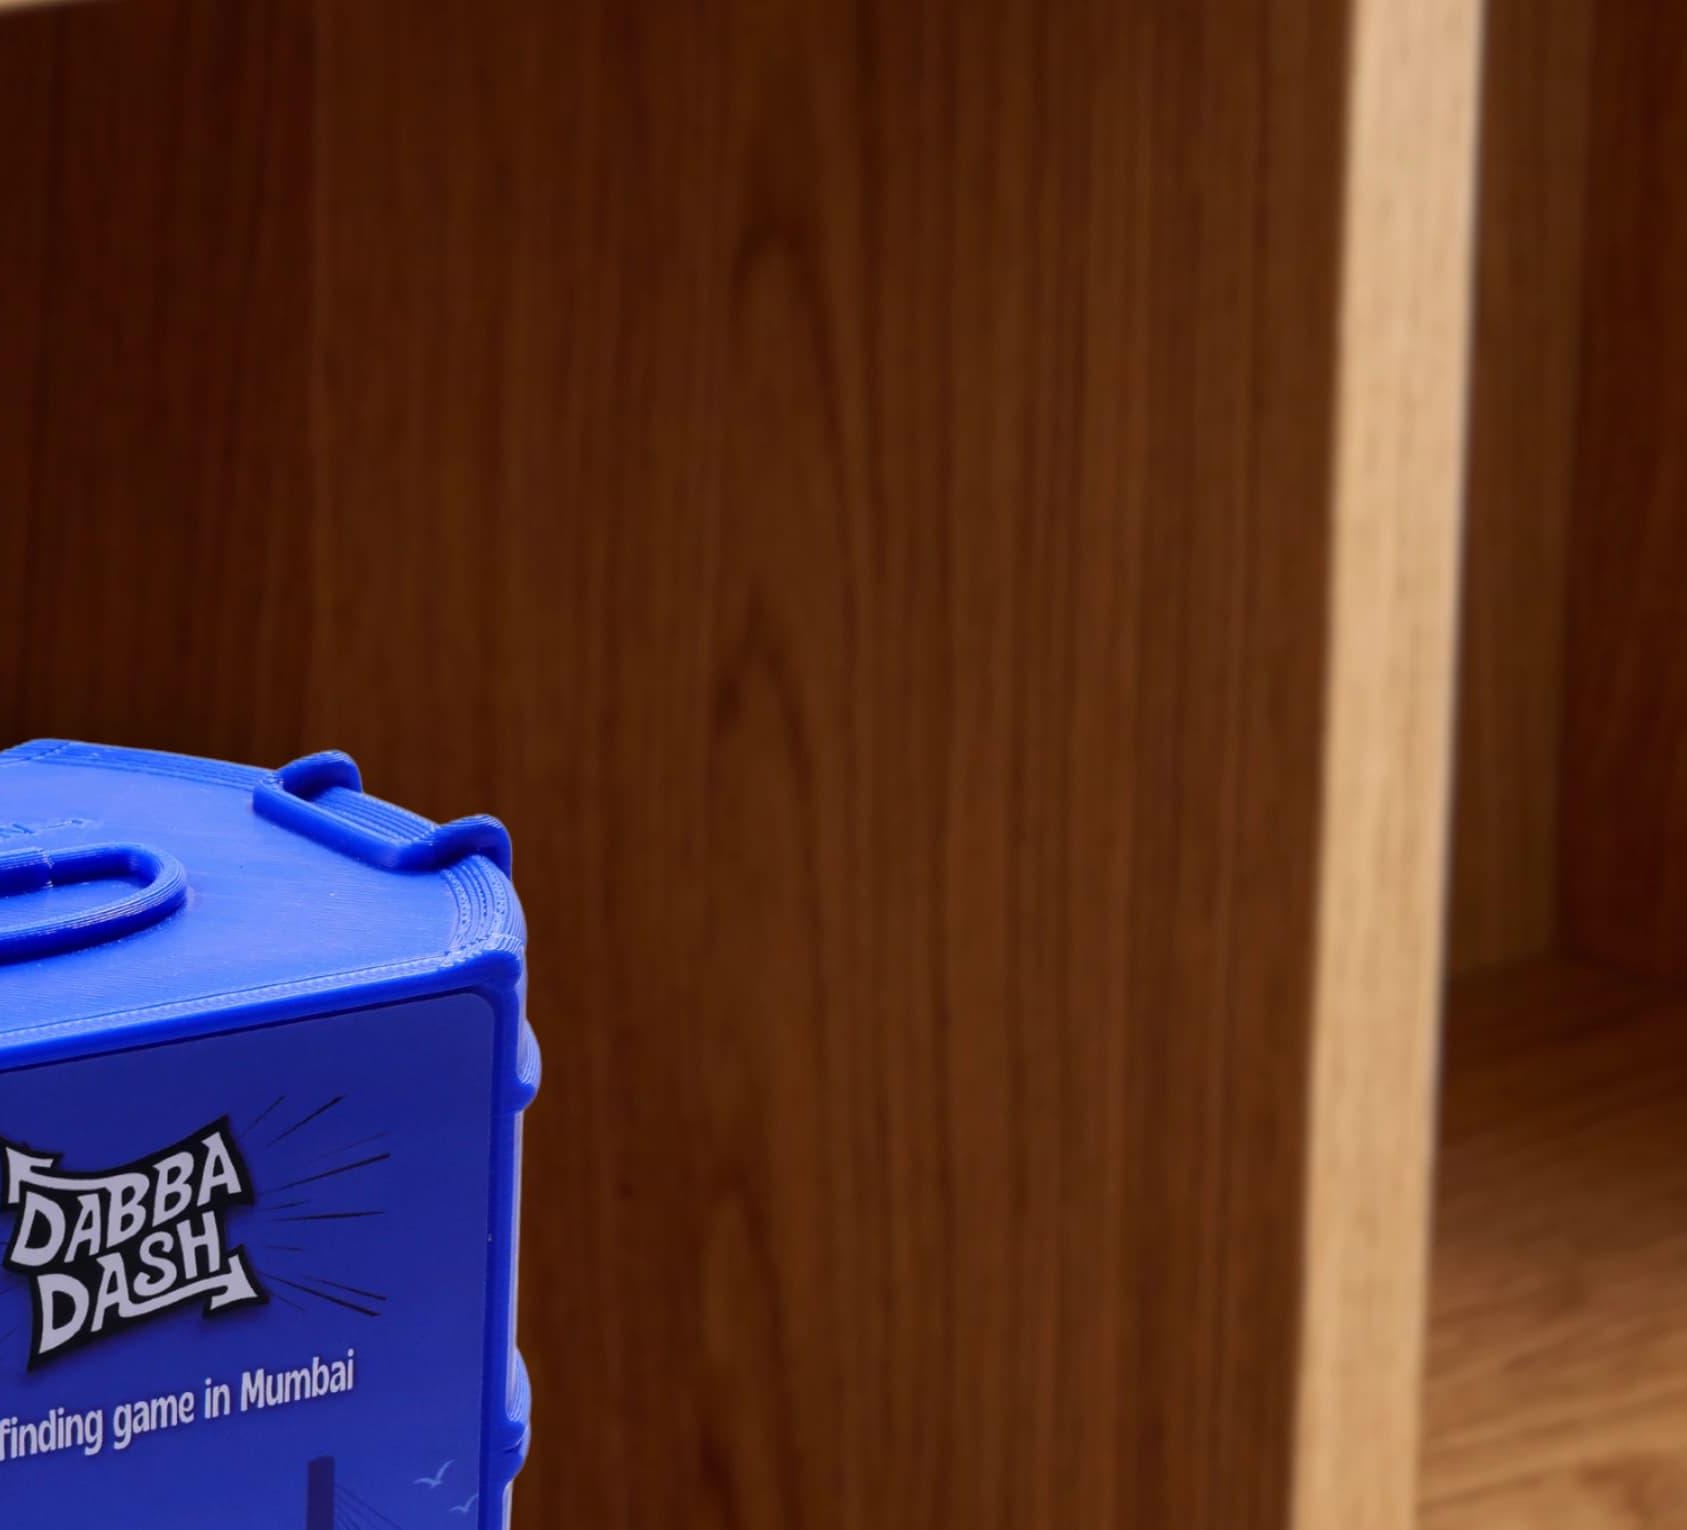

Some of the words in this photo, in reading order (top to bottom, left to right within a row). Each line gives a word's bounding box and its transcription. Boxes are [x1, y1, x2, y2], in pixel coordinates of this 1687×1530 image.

[6, 1132, 242, 1268] DABBA
[36, 1211, 258, 1354] DASH
[113, 1391, 194, 1450] game
[203, 1378, 231, 1419] in
[240, 1349, 355, 1412] Mumbai
